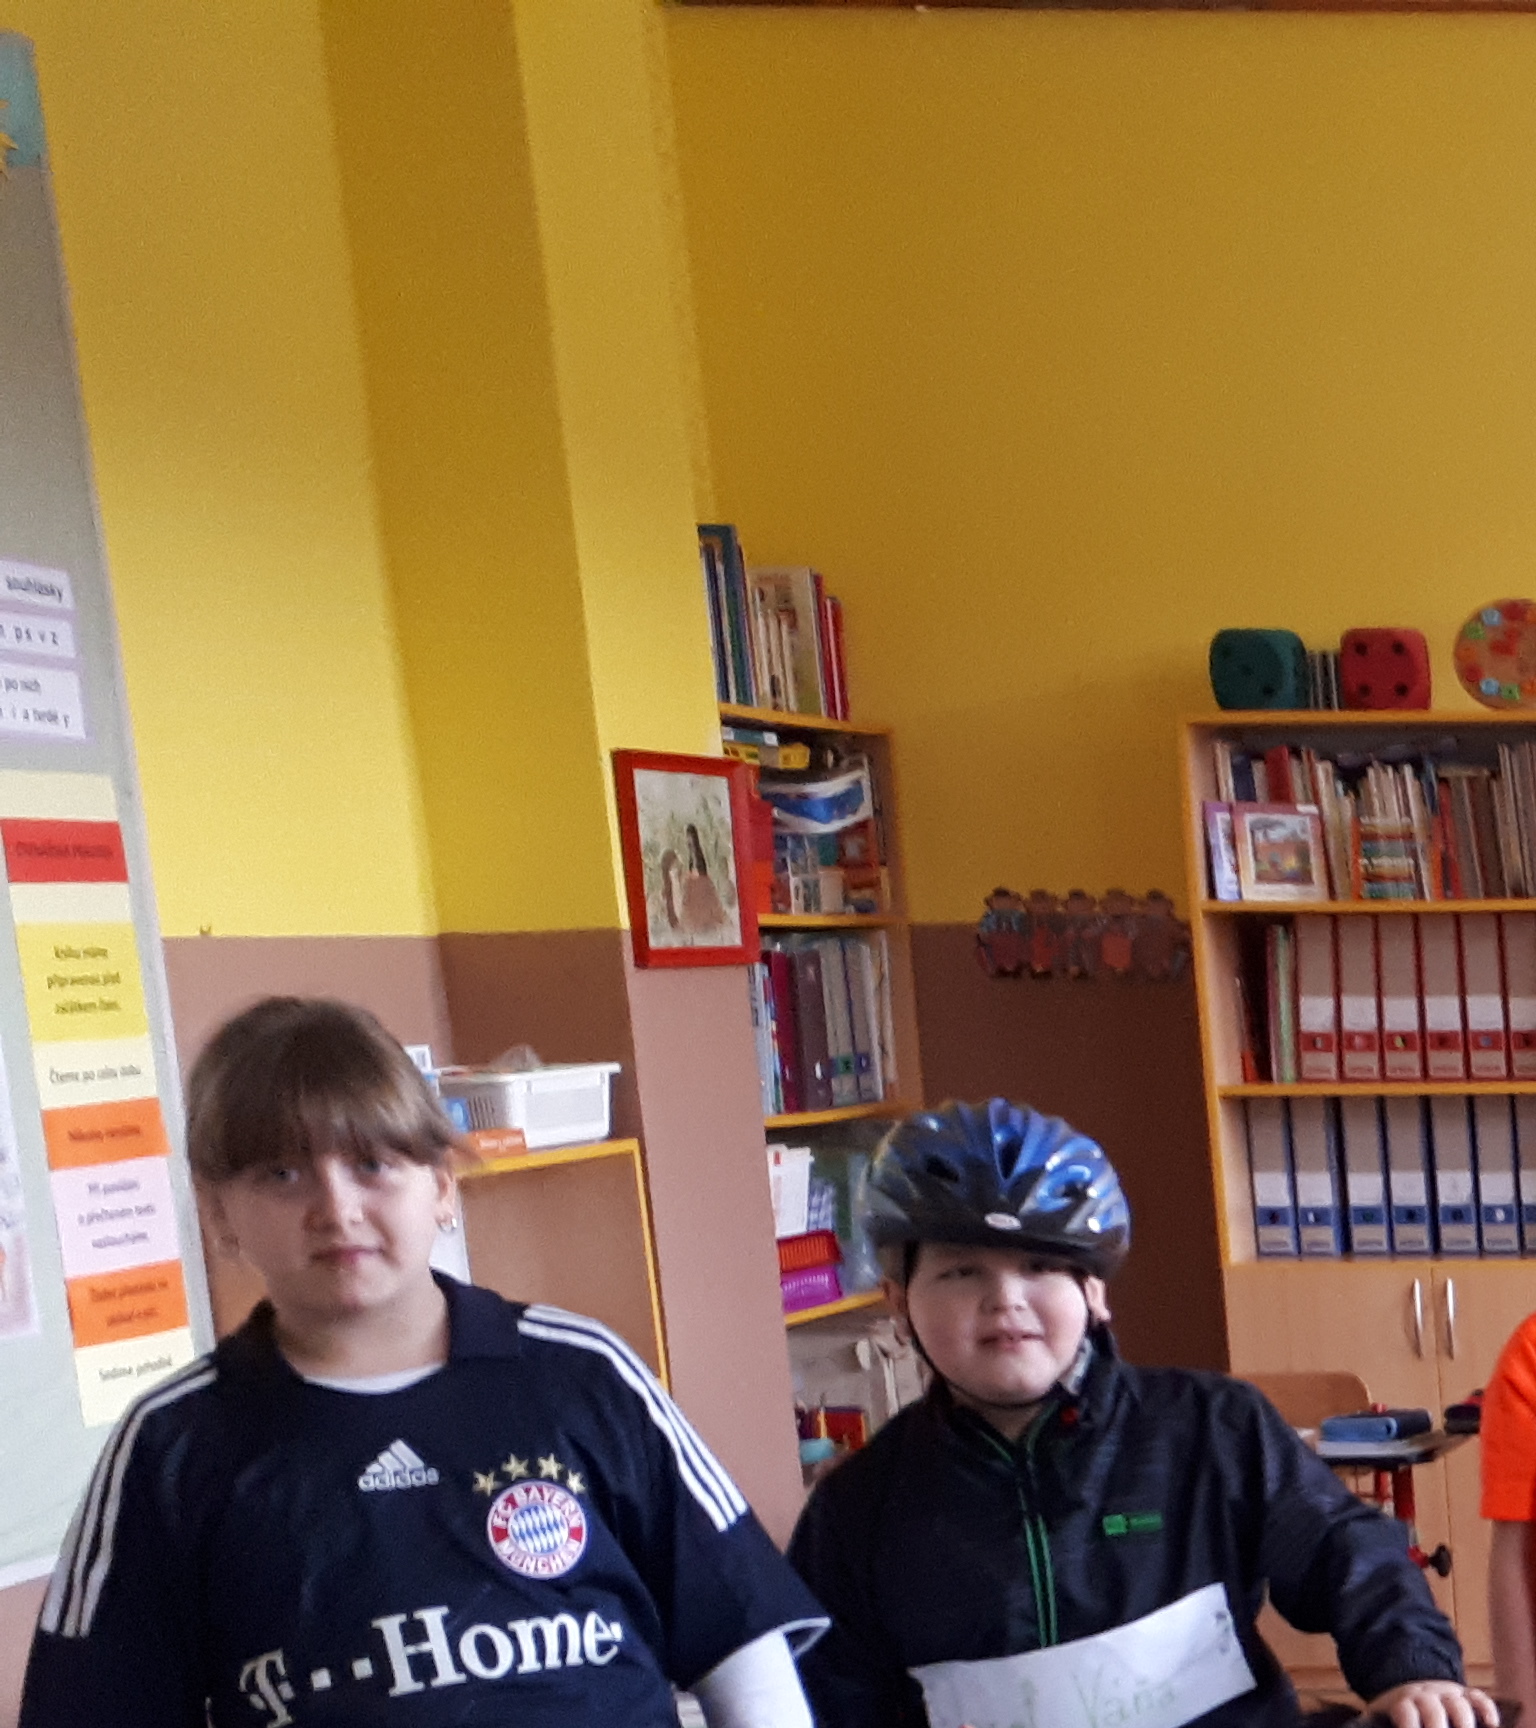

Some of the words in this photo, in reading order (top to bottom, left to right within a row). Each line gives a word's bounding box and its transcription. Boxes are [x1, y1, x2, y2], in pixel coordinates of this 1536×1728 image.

[357, 1467, 440, 1492] adidas
[492, 1502, 512, 1526] FC
[516, 1484, 581, 1527] BAYERN
[498, 1538, 582, 1575] MÜNCHEN
